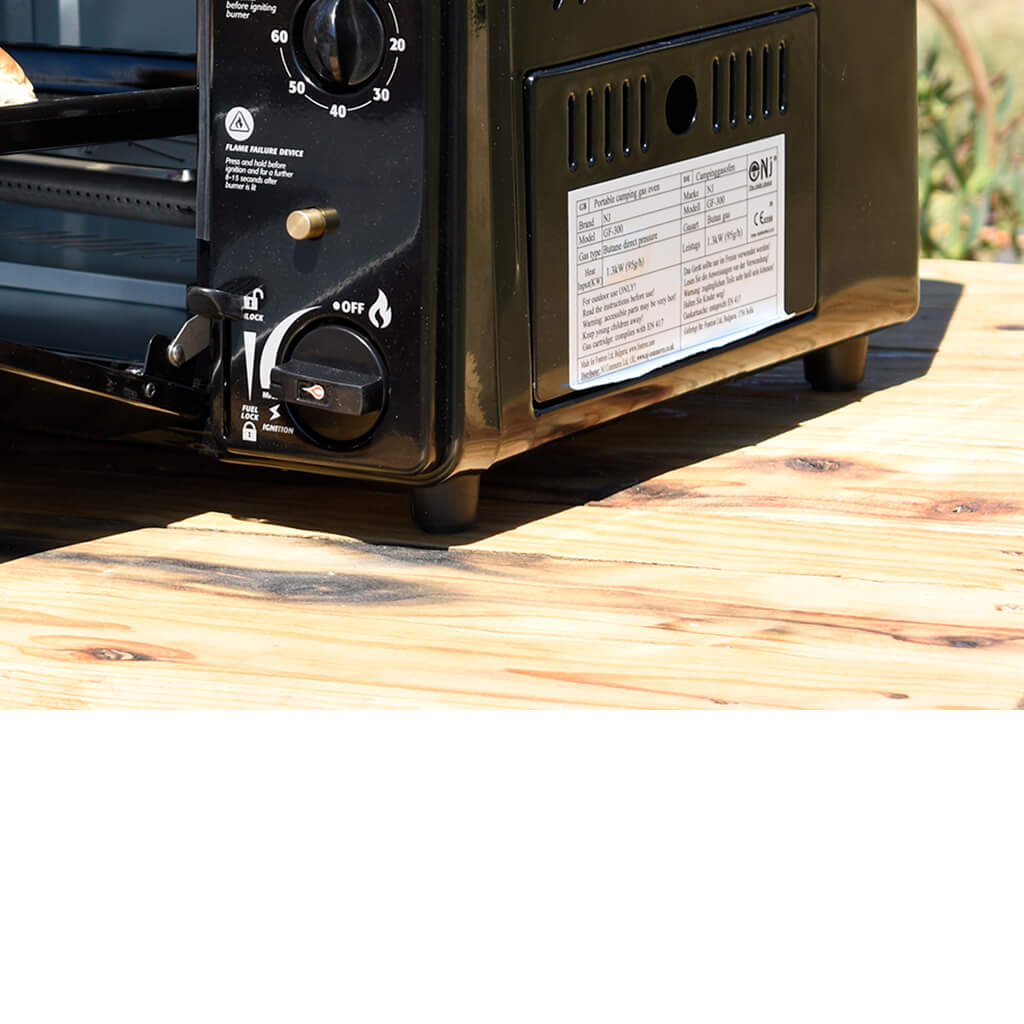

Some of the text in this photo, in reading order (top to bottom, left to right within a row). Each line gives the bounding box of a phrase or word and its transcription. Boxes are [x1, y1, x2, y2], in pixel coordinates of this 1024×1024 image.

[226, 2, 277, 15] before igniting
[226, 12, 251, 20] burner
[271, 30, 288, 43] 60
[390, 38, 405, 51] 20
[288, 81, 306, 95] 50
[373, 88, 390, 102] 30
[329, 104, 347, 119] 40
[225, 143, 304, 158] FLAME FAILURE DEVICE
[225, 166, 246, 175] ignition
[274, 169, 294, 178] further
[268, 161, 287, 170] before
[240, 176, 263, 184] seconds
[264, 177, 278, 185] after
[593, 194, 615, 208] Portable
[615, 190, 637, 202] camping
[638, 188, 646, 198] gas
[647, 184, 660, 193] oven
[578, 217, 594, 230] Brand
[578, 231, 595, 244] Model
[578, 252, 589, 261] Gas
[602, 243, 622, 254] Butane
[623, 238, 637, 249] direct
[638, 232, 658, 247] pressure
[582, 297, 590, 306] For
[591, 293, 609, 303] outdoor
[582, 307, 594, 317] Read
[603, 298, 629, 311] instructions
[630, 293, 644, 302] before
[342, 301, 365, 314] OFF
[627, 306, 639, 316] parts
[582, 331, 594, 340] Keep
[595, 326, 610, 337] young
[610, 320, 629, 331] children
[582, 342, 591, 351] Gas
[242, 404, 258, 413] FUEL
[241, 412, 259, 421] LOCK
[262, 423, 295, 434] IGNITION
